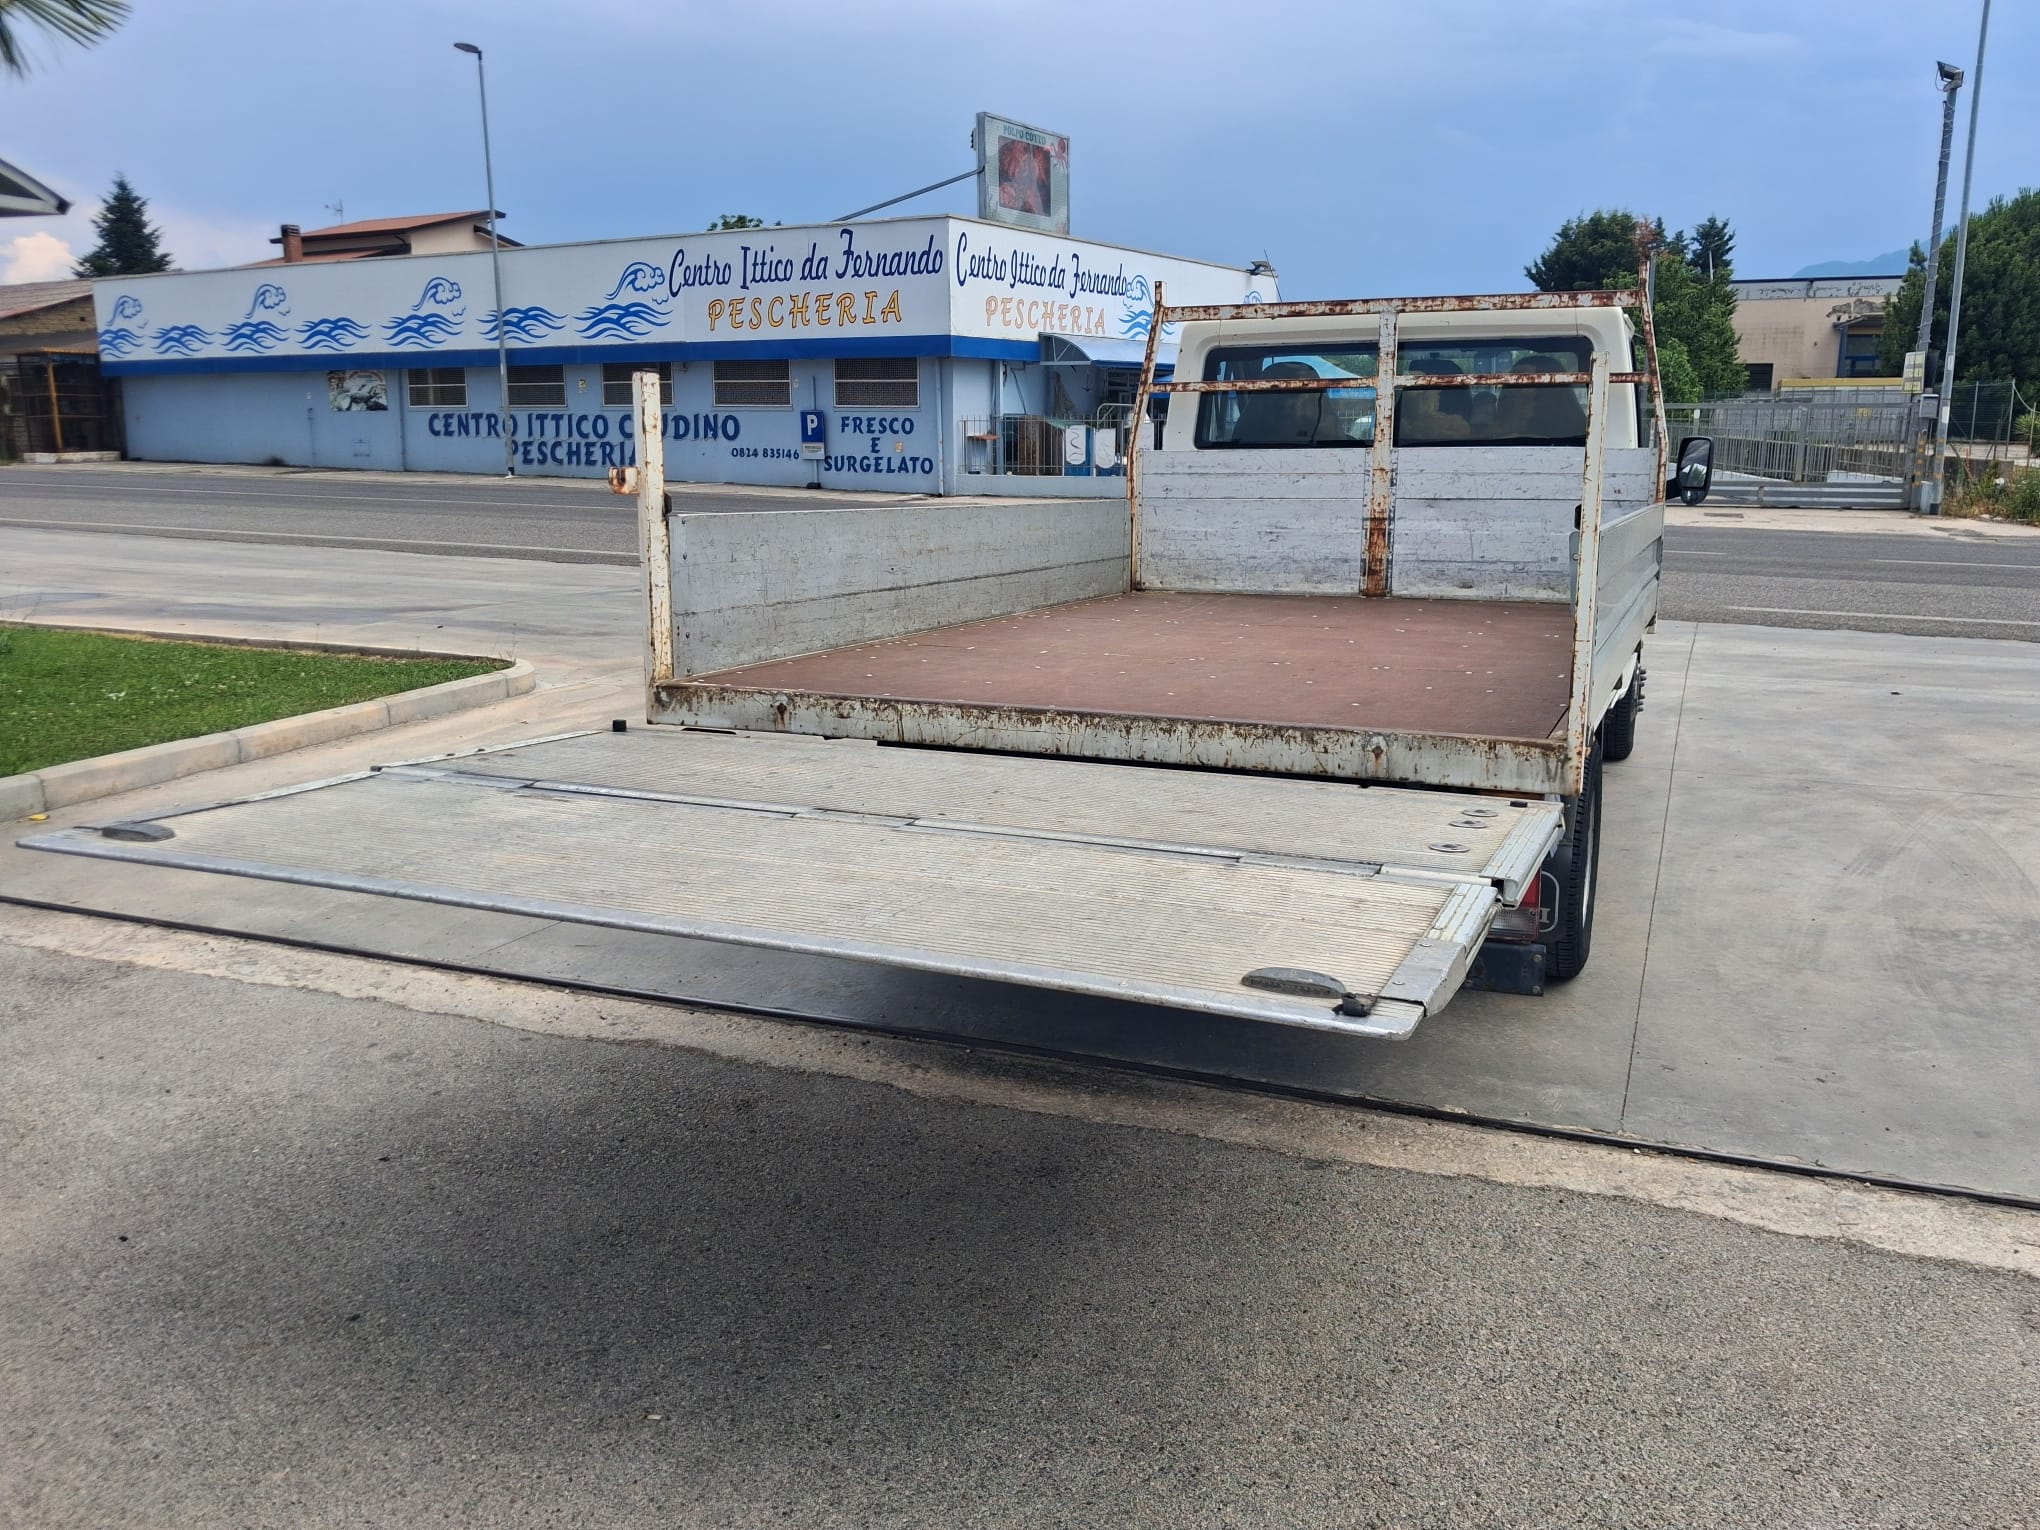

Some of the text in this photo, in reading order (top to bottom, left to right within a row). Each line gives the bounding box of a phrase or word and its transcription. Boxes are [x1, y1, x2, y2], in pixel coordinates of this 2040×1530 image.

[669, 228, 944, 298] Centro Ittico da Fernando
[956, 232, 1128, 299] Centro Ittico da Fernando
[707, 290, 902, 332] PESCHERIA
[985, 295, 1107, 334] PESCHERIA
[428, 412, 740, 441] CENTRO ITTICO CDINO
[806, 414, 818, 436] P
[841, 416, 915, 435] FRESCO
[731, 447, 758, 458] 0824
[762, 448, 800, 460] 835146
[870, 437, 881, 454] E
[824, 455, 934, 475] SURGELATO
